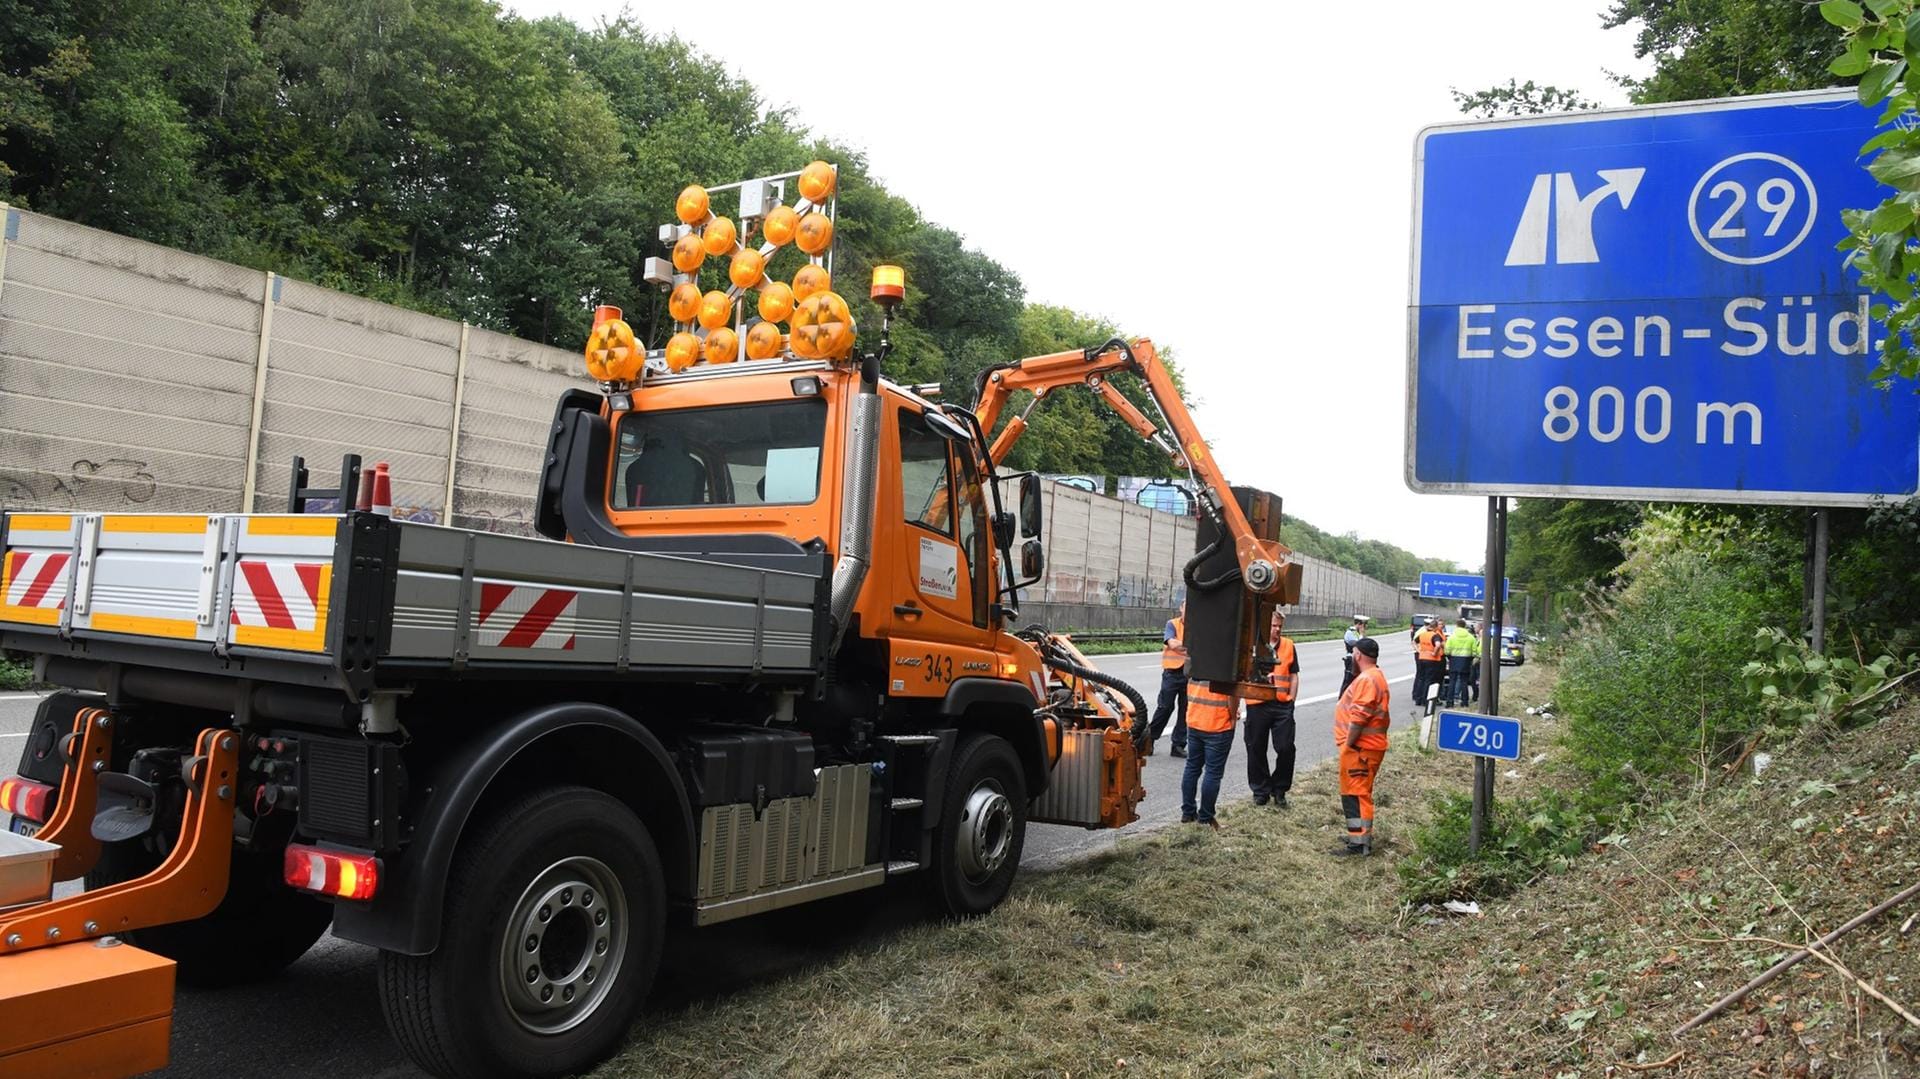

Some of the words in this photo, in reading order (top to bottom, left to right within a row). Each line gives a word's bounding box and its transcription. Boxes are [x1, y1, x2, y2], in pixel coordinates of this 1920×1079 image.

[1708, 178, 1796, 239] 29
[1458, 295, 1869, 359] Essen-Süd
[1543, 385, 1672, 443] 800
[1696, 402, 1762, 445] m
[924, 654, 953, 683] 343
[1458, 722, 1504, 750] 79,0
